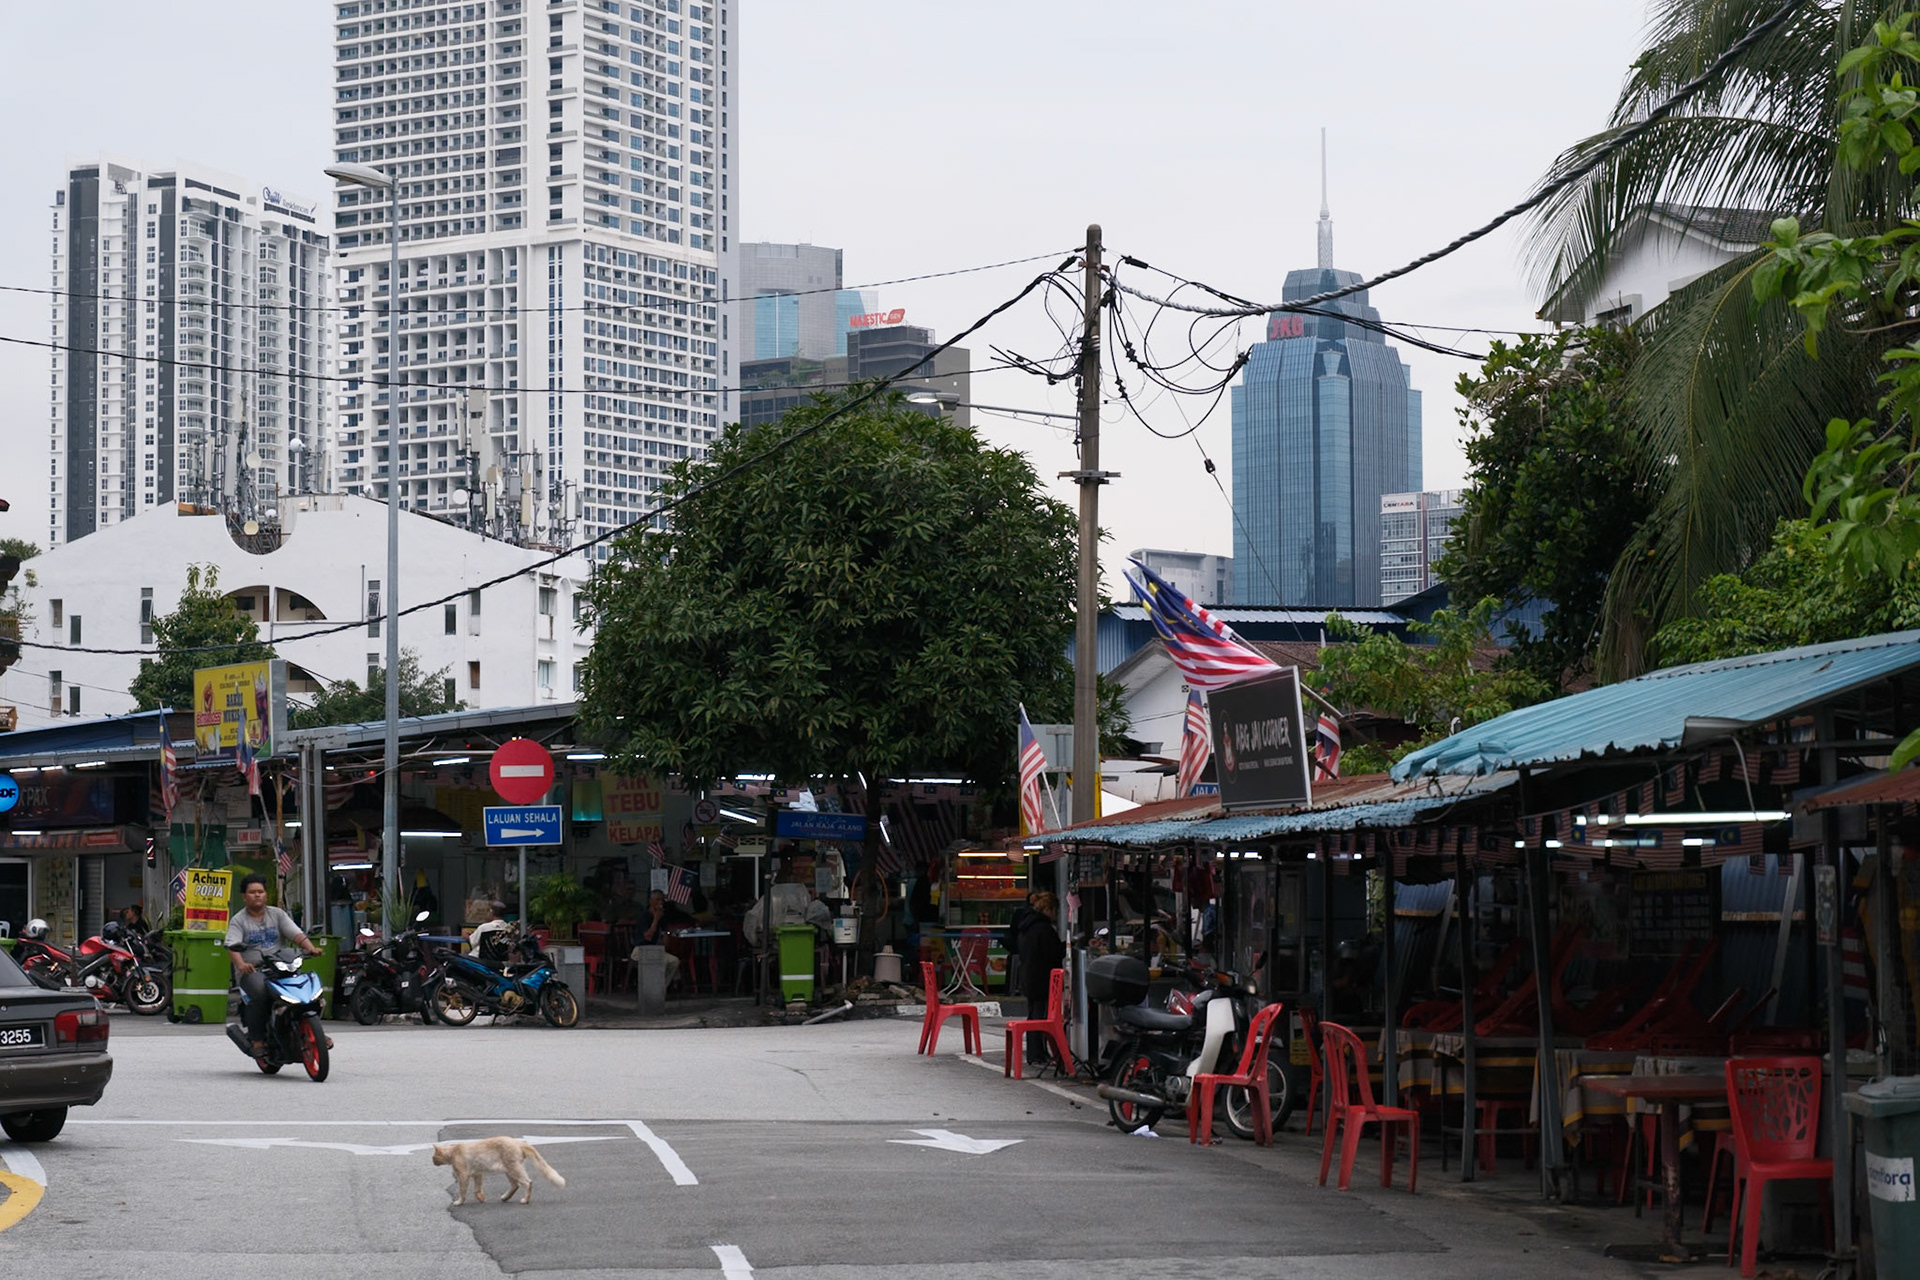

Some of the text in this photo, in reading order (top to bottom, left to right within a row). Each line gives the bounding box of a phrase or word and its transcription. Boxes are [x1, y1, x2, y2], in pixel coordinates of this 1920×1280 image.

[849, 312, 887, 328] MAJESTIC
[1269, 315, 1304, 340] JKG
[1262, 716, 1292, 750] CORNER
[607, 792, 660, 813] TEBU
[488, 812, 557, 824] LALUAN SEHALA
[790, 820, 814, 828] JALAN
[816, 821, 835, 830] RAJA
[609, 826, 662, 843] KELAPA
[192, 872, 227, 885] Achun
[194, 884, 224, 898] POPIA
[0, 1029, 32, 1044] 3255
